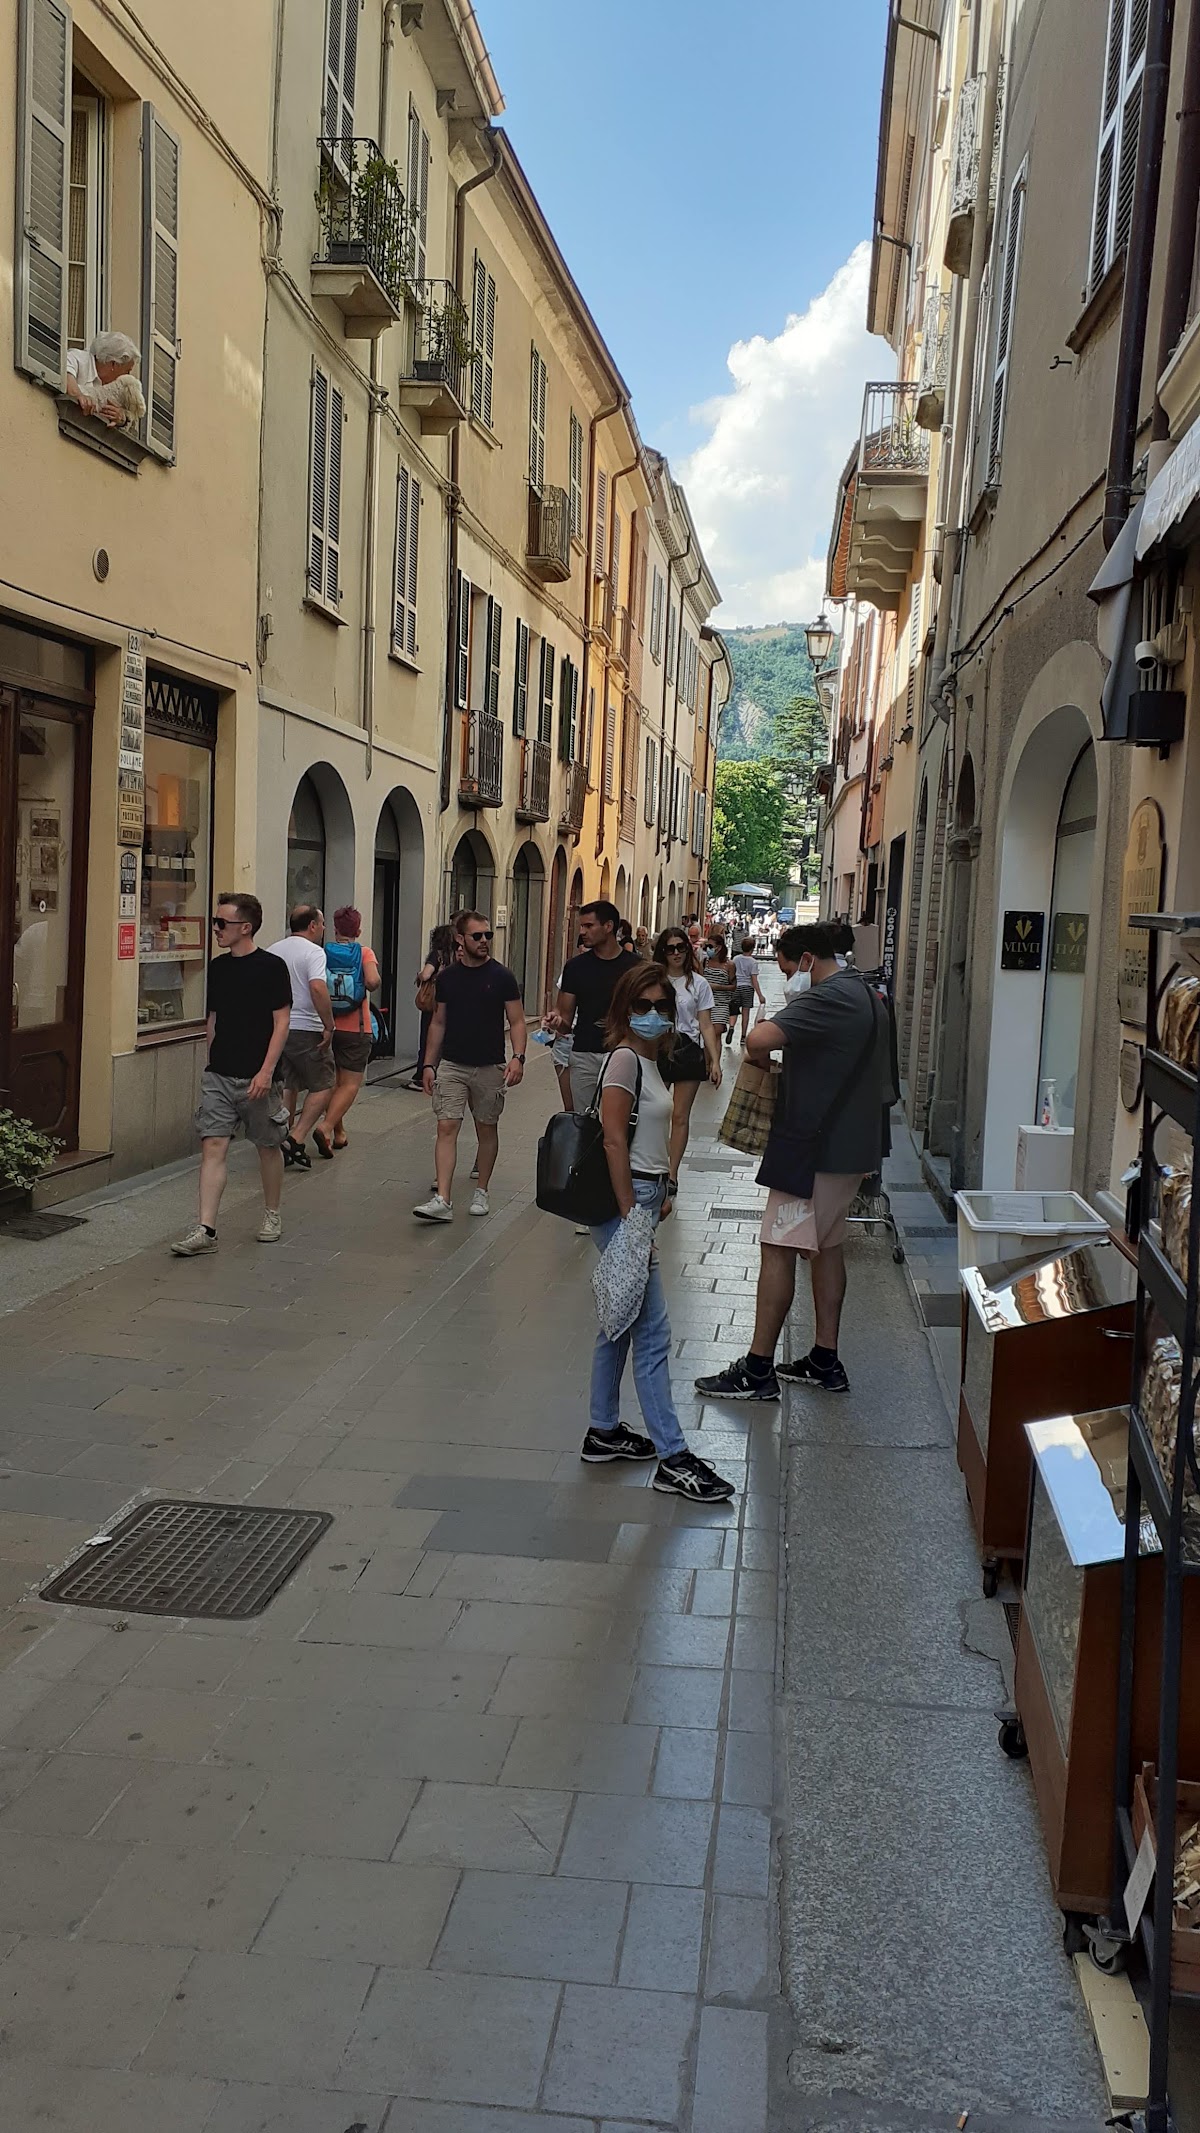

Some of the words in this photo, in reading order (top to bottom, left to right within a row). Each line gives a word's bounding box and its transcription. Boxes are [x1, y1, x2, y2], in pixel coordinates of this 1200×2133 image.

[120, 753, 142, 768] POLLAME
[1004, 941, 1041, 954] VELVET
[778, 1200, 808, 1223] NIKE
